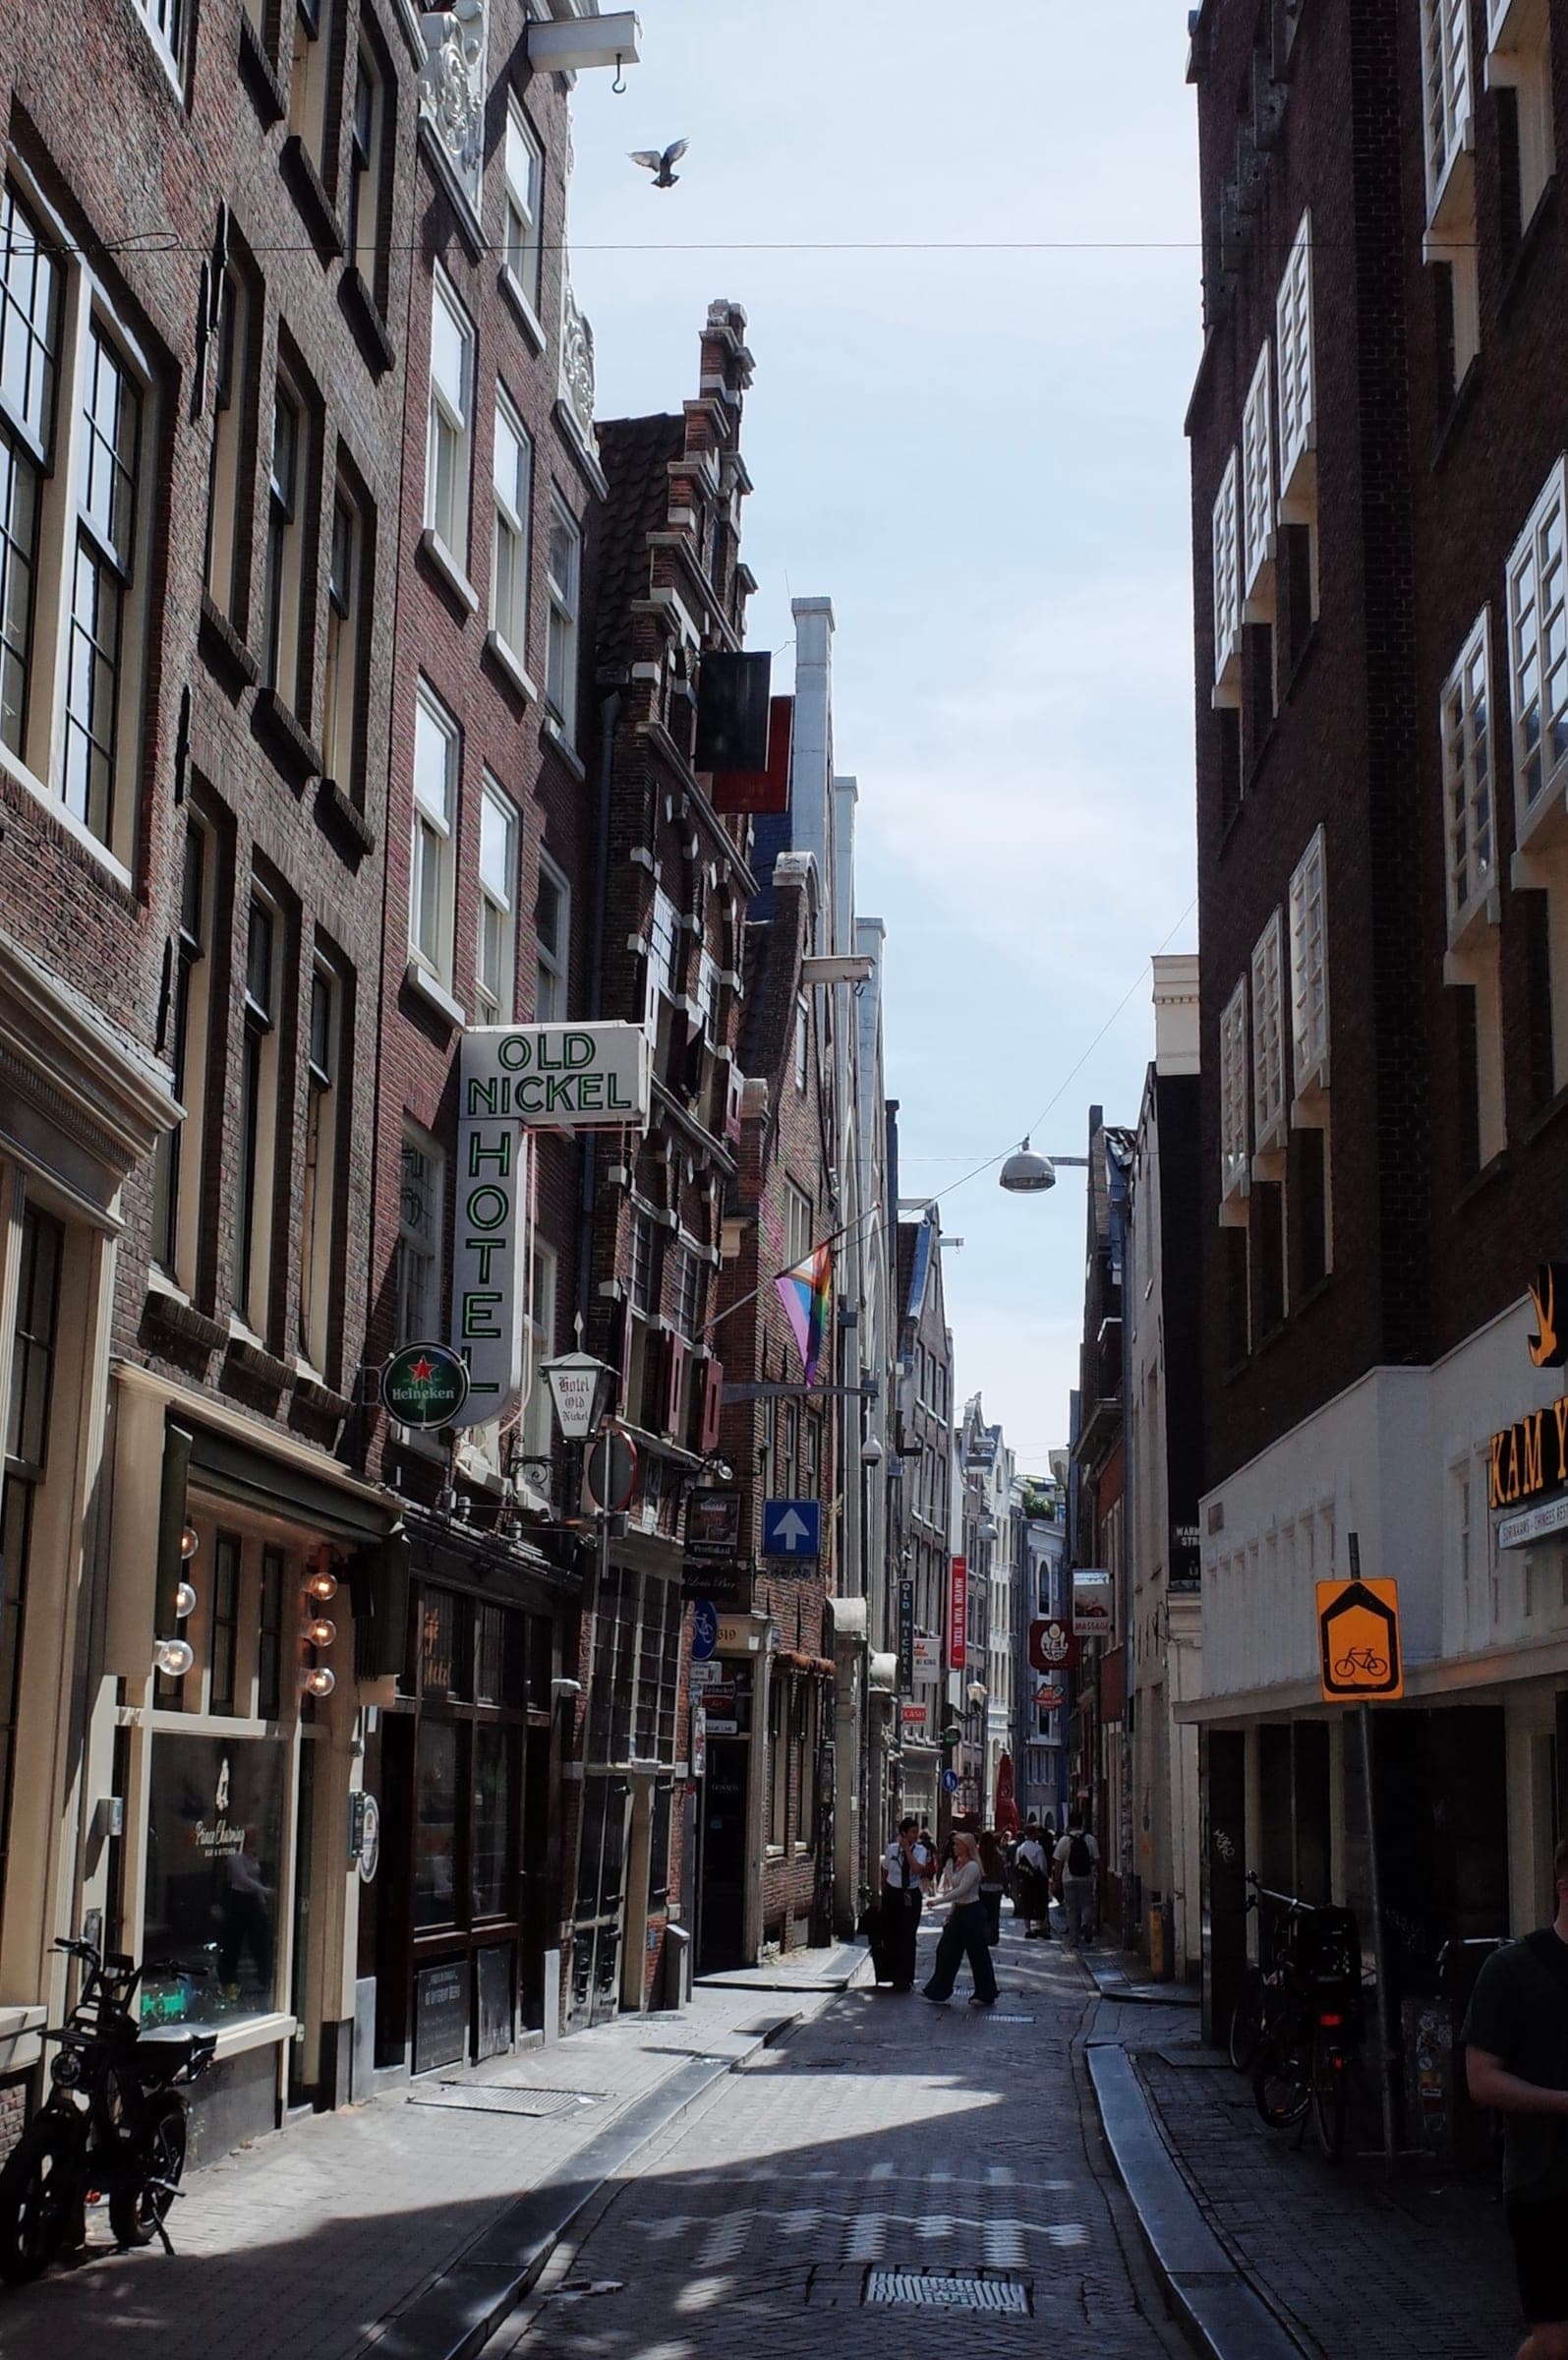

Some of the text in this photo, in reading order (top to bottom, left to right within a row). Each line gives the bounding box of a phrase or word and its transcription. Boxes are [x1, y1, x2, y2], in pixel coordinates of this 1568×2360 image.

[498, 1032, 596, 1071] OLD
[467, 1072, 632, 1115] NICKEL
[462, 1132, 510, 1393] HOTEL
[558, 1376, 590, 1392] Hotel
[392, 1387, 455, 1400] Heineken
[564, 1396, 585, 1409] Old
[561, 1410, 589, 1422] Nickel
[1490, 1410, 1543, 1509] KAM
[1556, 1504, 1568, 1521] RES
